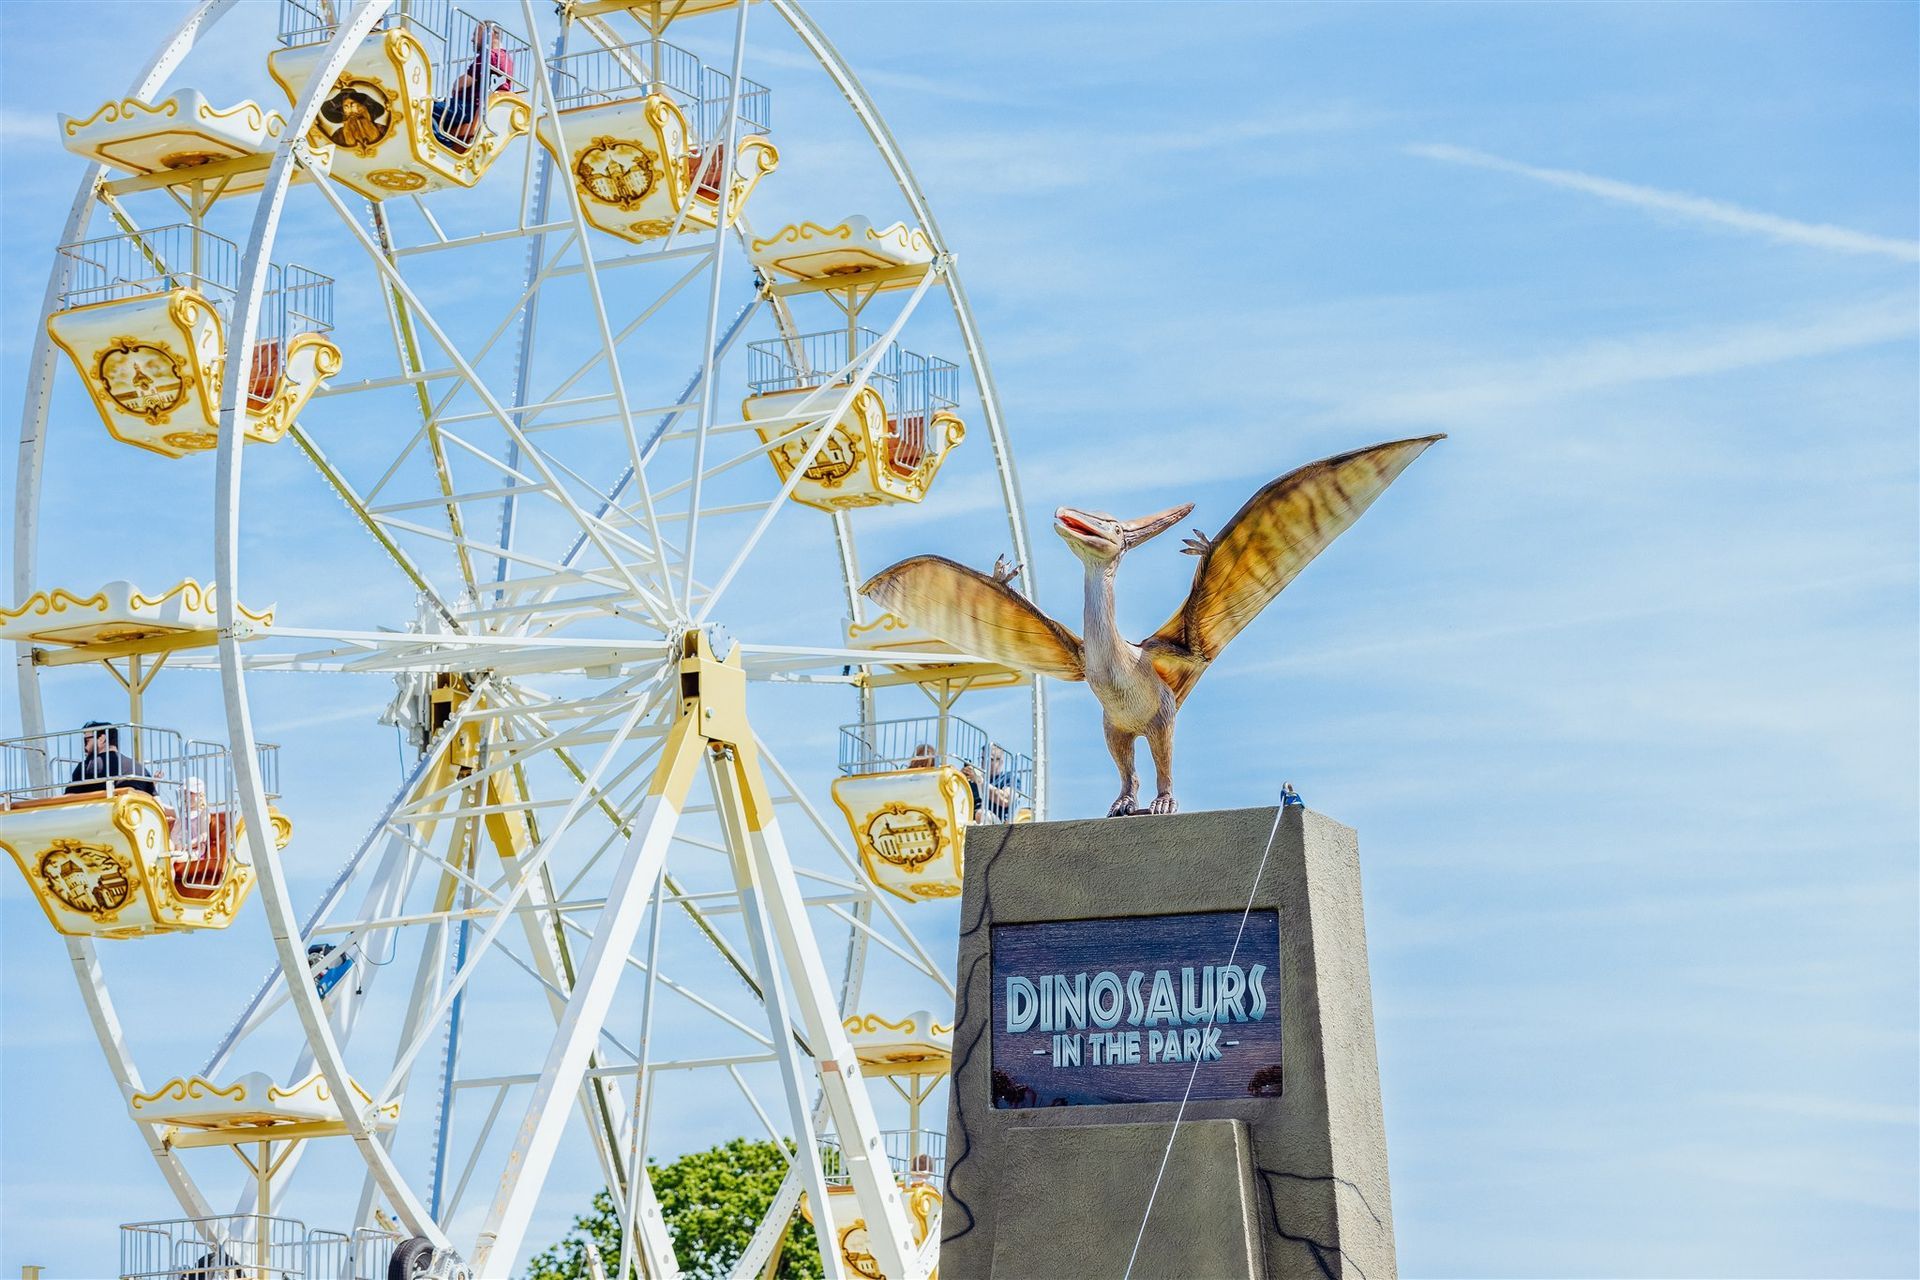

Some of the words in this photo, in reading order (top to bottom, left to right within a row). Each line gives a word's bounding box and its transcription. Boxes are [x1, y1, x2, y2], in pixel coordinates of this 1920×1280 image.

[412, 65, 421, 85] 8
[671, 130, 679, 147] 9
[203, 328, 213, 349] 7
[870, 412, 881, 430] 10
[145, 828, 156, 850] 6
[1006, 963, 1268, 1034] DINOSAURS
[1088, 1030, 1141, 1066] THE
